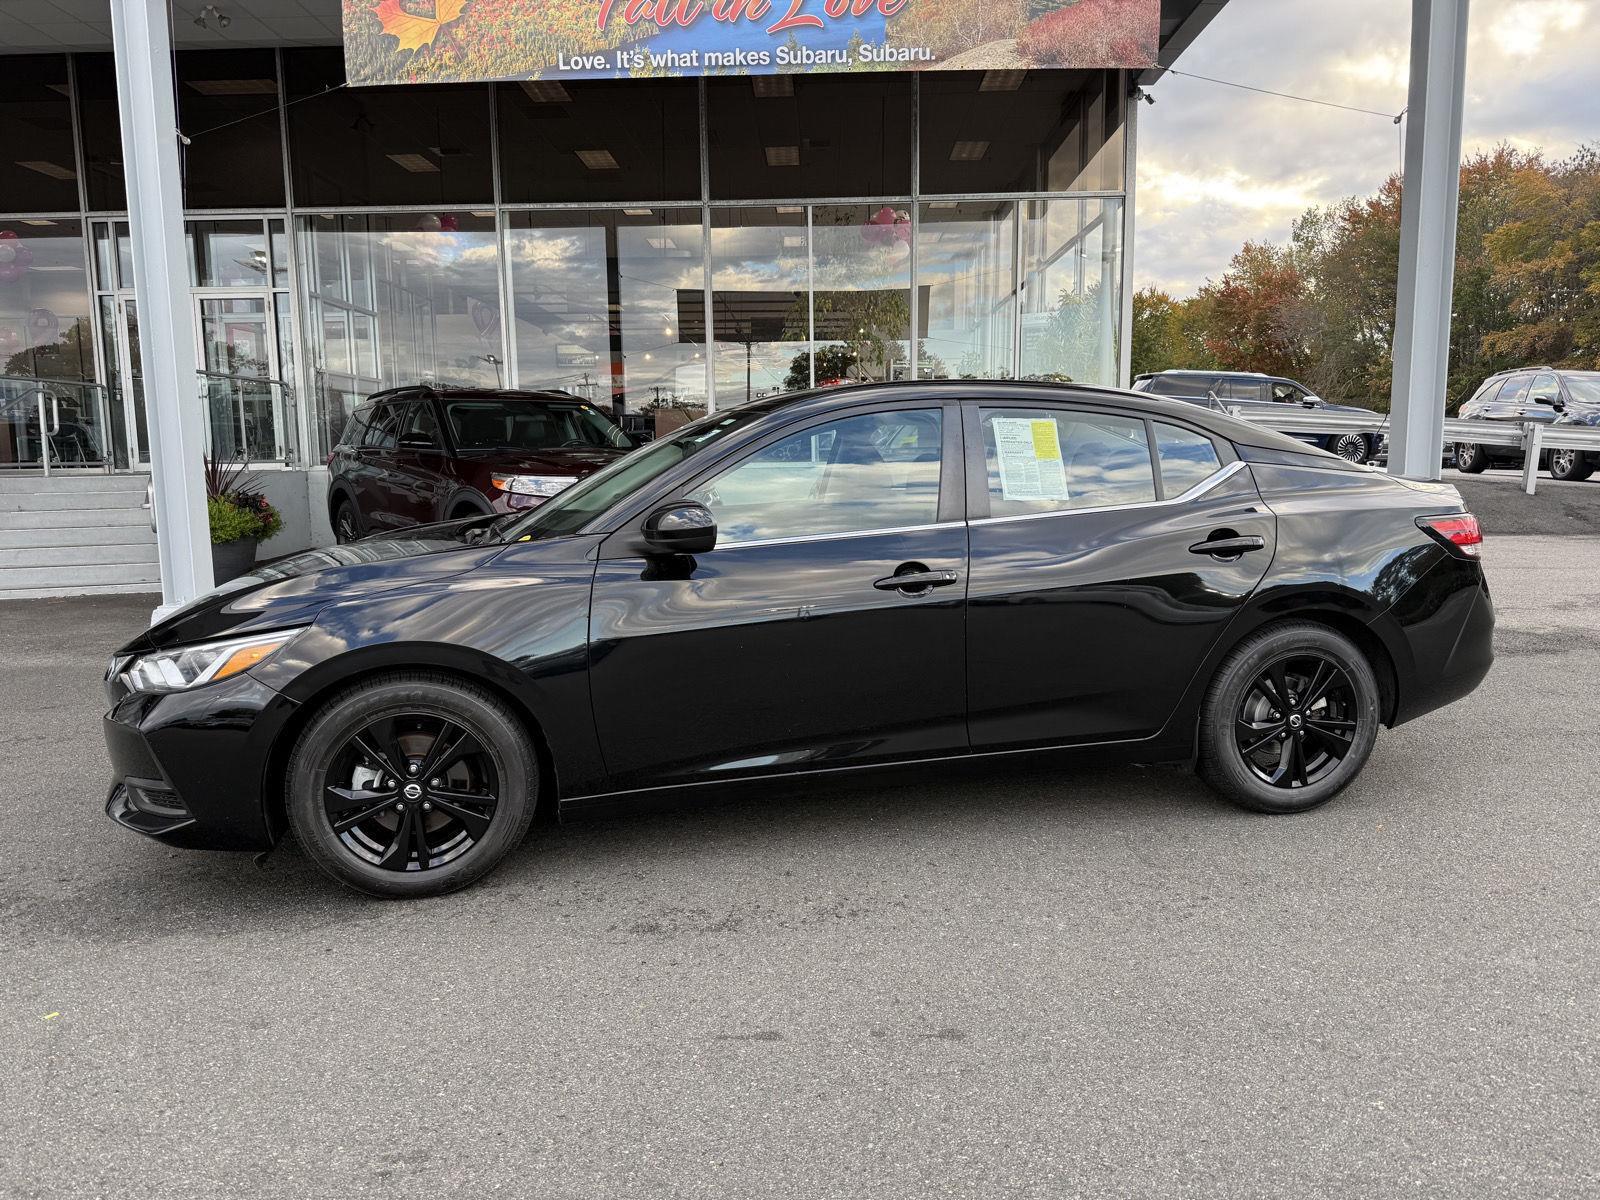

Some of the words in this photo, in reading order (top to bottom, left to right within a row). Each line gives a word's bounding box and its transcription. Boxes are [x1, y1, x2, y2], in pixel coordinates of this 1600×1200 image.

[558, 52, 611, 71] Love.
[616, 50, 645, 69] It’s
[649, 49, 699, 67] what
[704, 47, 770, 66] makes
[775, 45, 853, 66] Subaru,
[858, 44, 936, 63] Subaru.
